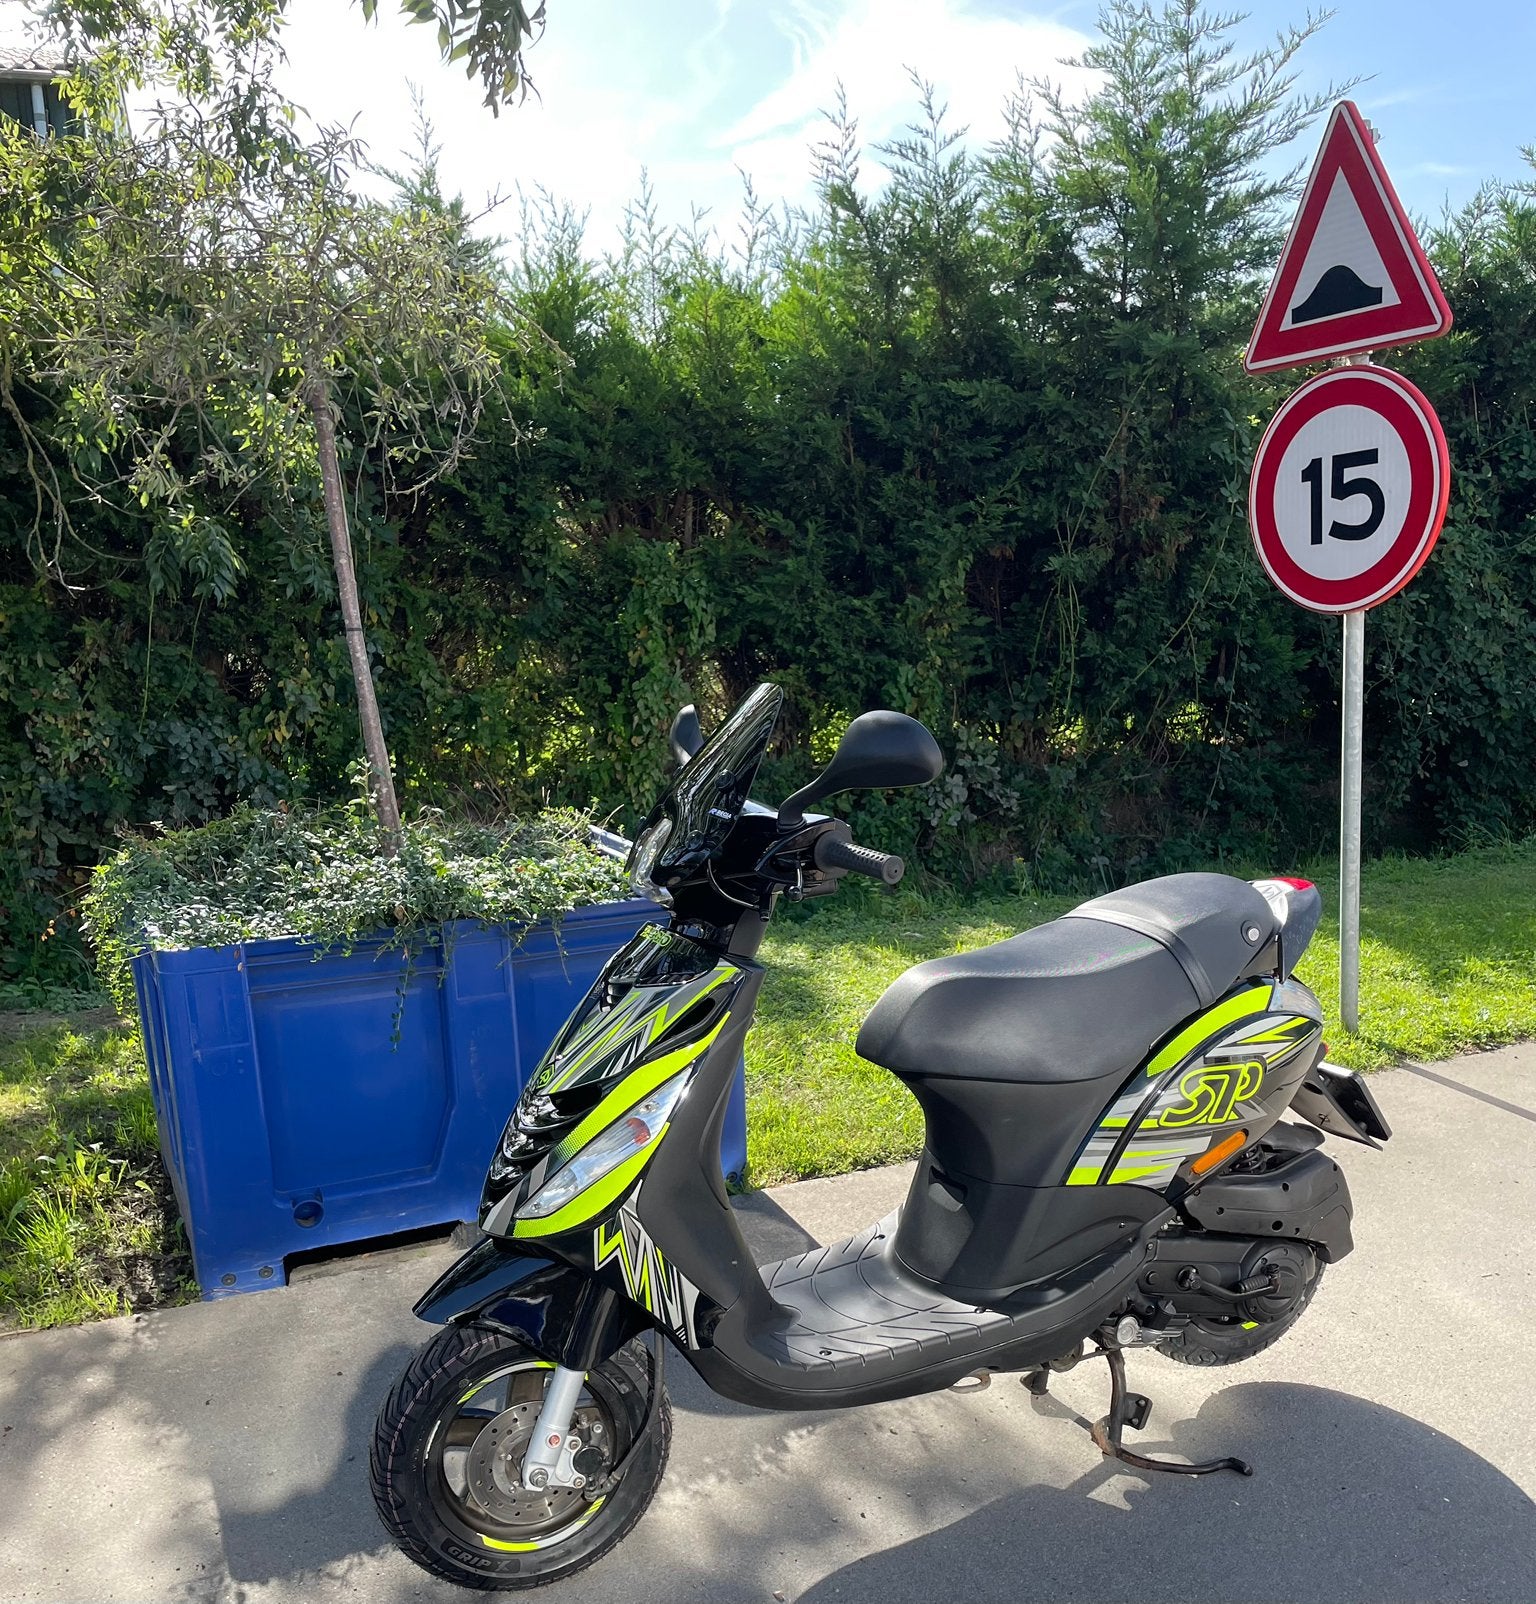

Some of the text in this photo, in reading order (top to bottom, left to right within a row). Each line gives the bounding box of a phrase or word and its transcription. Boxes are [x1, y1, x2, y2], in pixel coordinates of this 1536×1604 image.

[1301, 447, 1386, 546] 15
[1159, 1061, 1263, 1127] SP
[447, 1545, 492, 1567] GRIP
